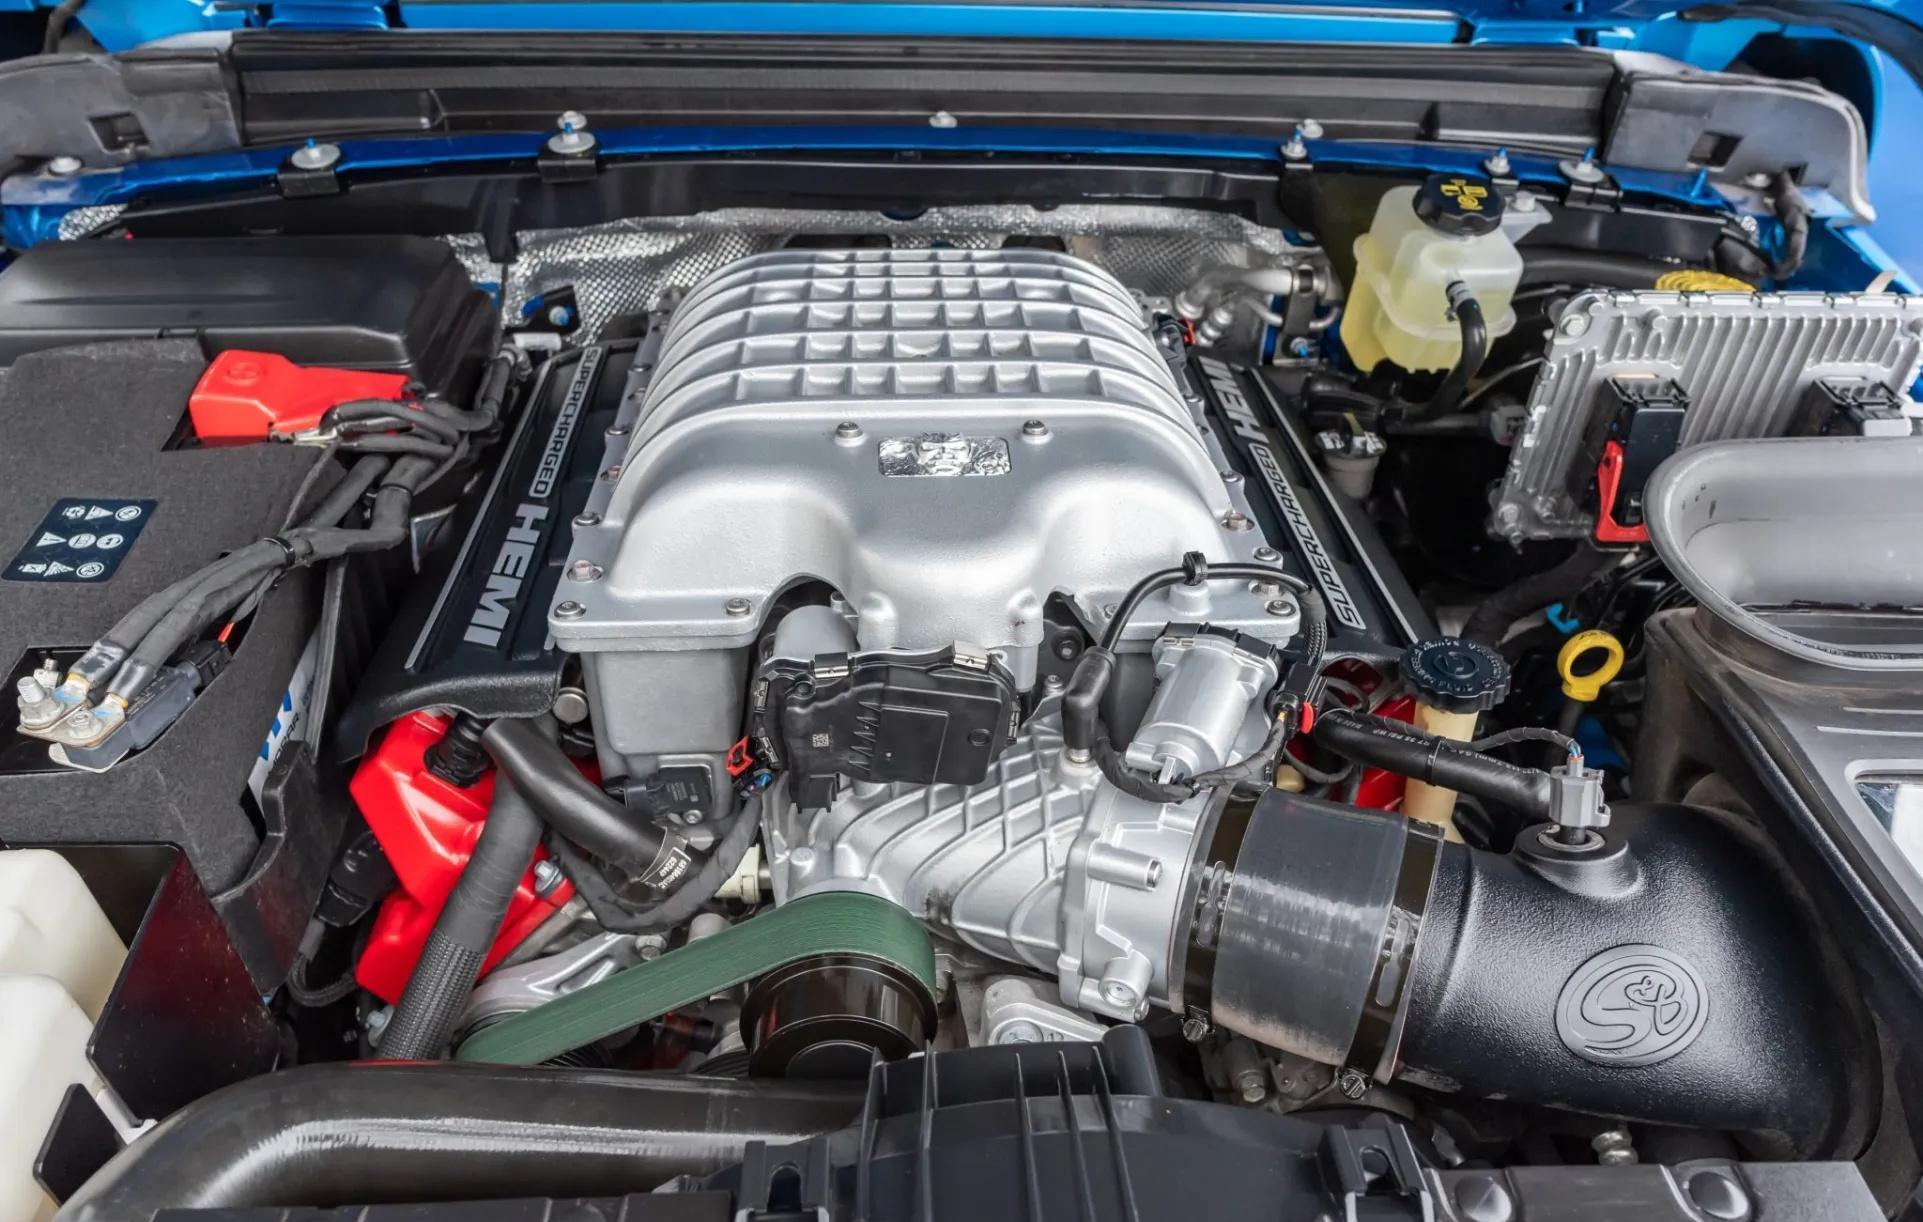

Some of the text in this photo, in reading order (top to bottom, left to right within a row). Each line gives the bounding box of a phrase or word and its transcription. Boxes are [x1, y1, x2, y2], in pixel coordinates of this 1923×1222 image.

[1198, 356, 1270, 444] HEMI
[463, 348, 599, 647] SUPERCHARGED HEMI
[1252, 445, 1359, 626] SUPERCHARGED
